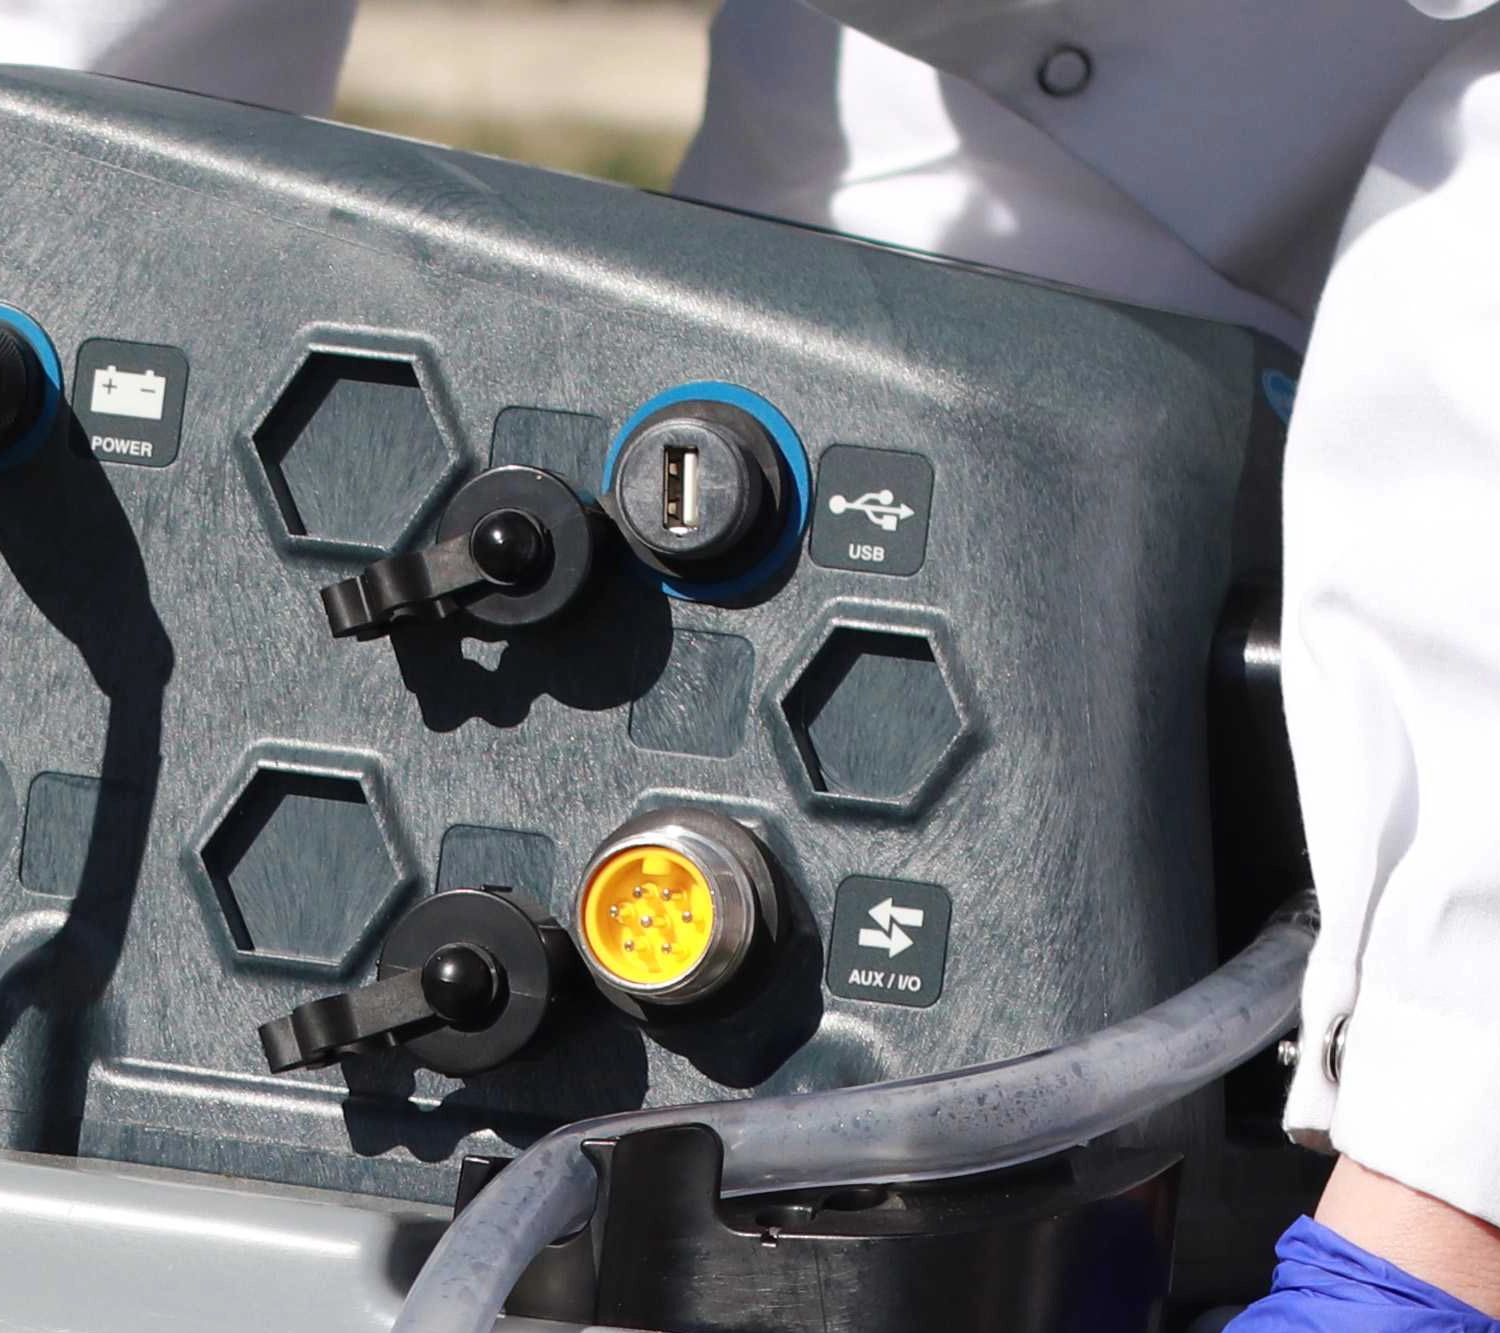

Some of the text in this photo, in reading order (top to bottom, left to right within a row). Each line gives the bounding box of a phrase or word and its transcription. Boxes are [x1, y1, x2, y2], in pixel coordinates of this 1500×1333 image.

[91, 435, 153, 457] POWER
[849, 543, 885, 562] USB
[848, 968, 884, 988] AUX
